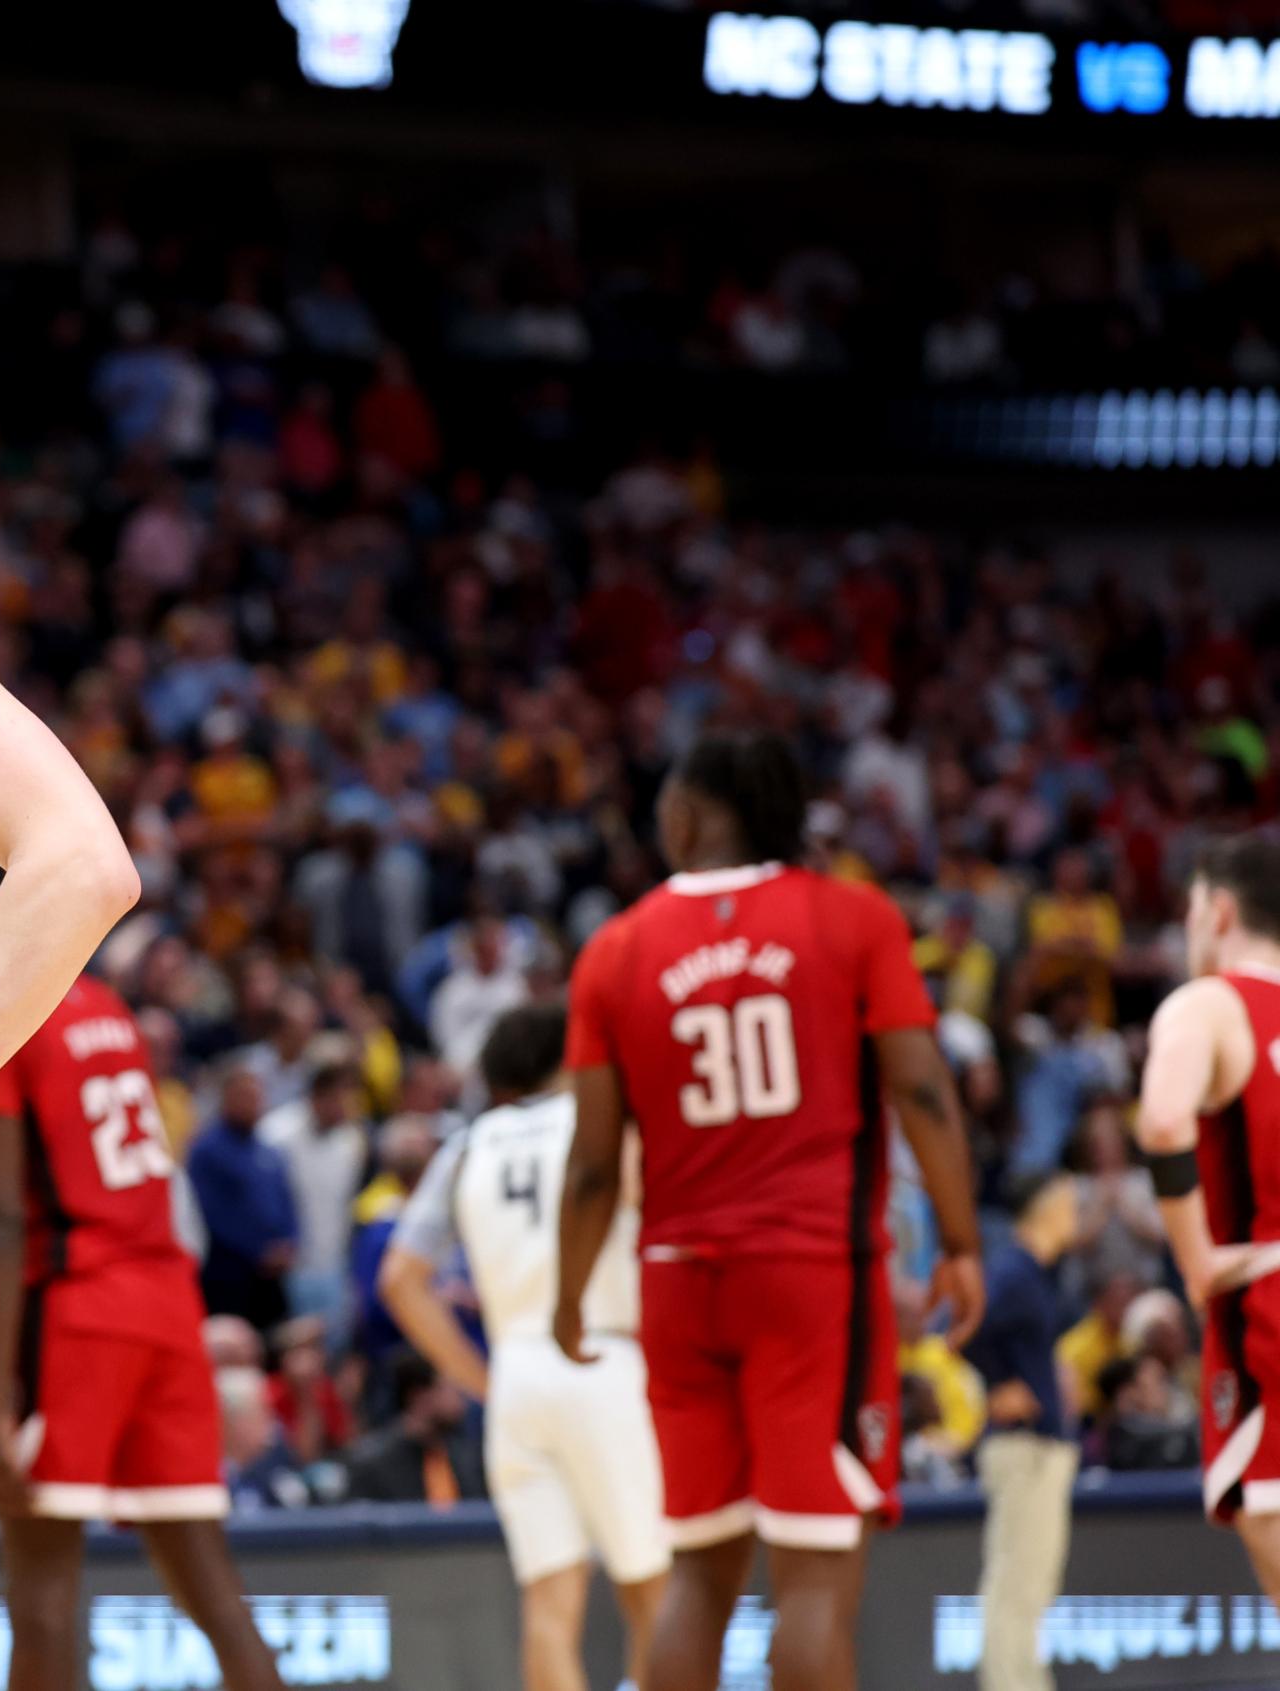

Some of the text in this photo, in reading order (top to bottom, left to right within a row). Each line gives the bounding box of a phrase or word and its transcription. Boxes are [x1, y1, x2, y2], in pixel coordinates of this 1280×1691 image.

[822, 20, 1055, 115] STATE
[671, 992, 802, 1128] 30
[81, 1068, 170, 1190] 23
[502, 1155, 541, 1228] 4
